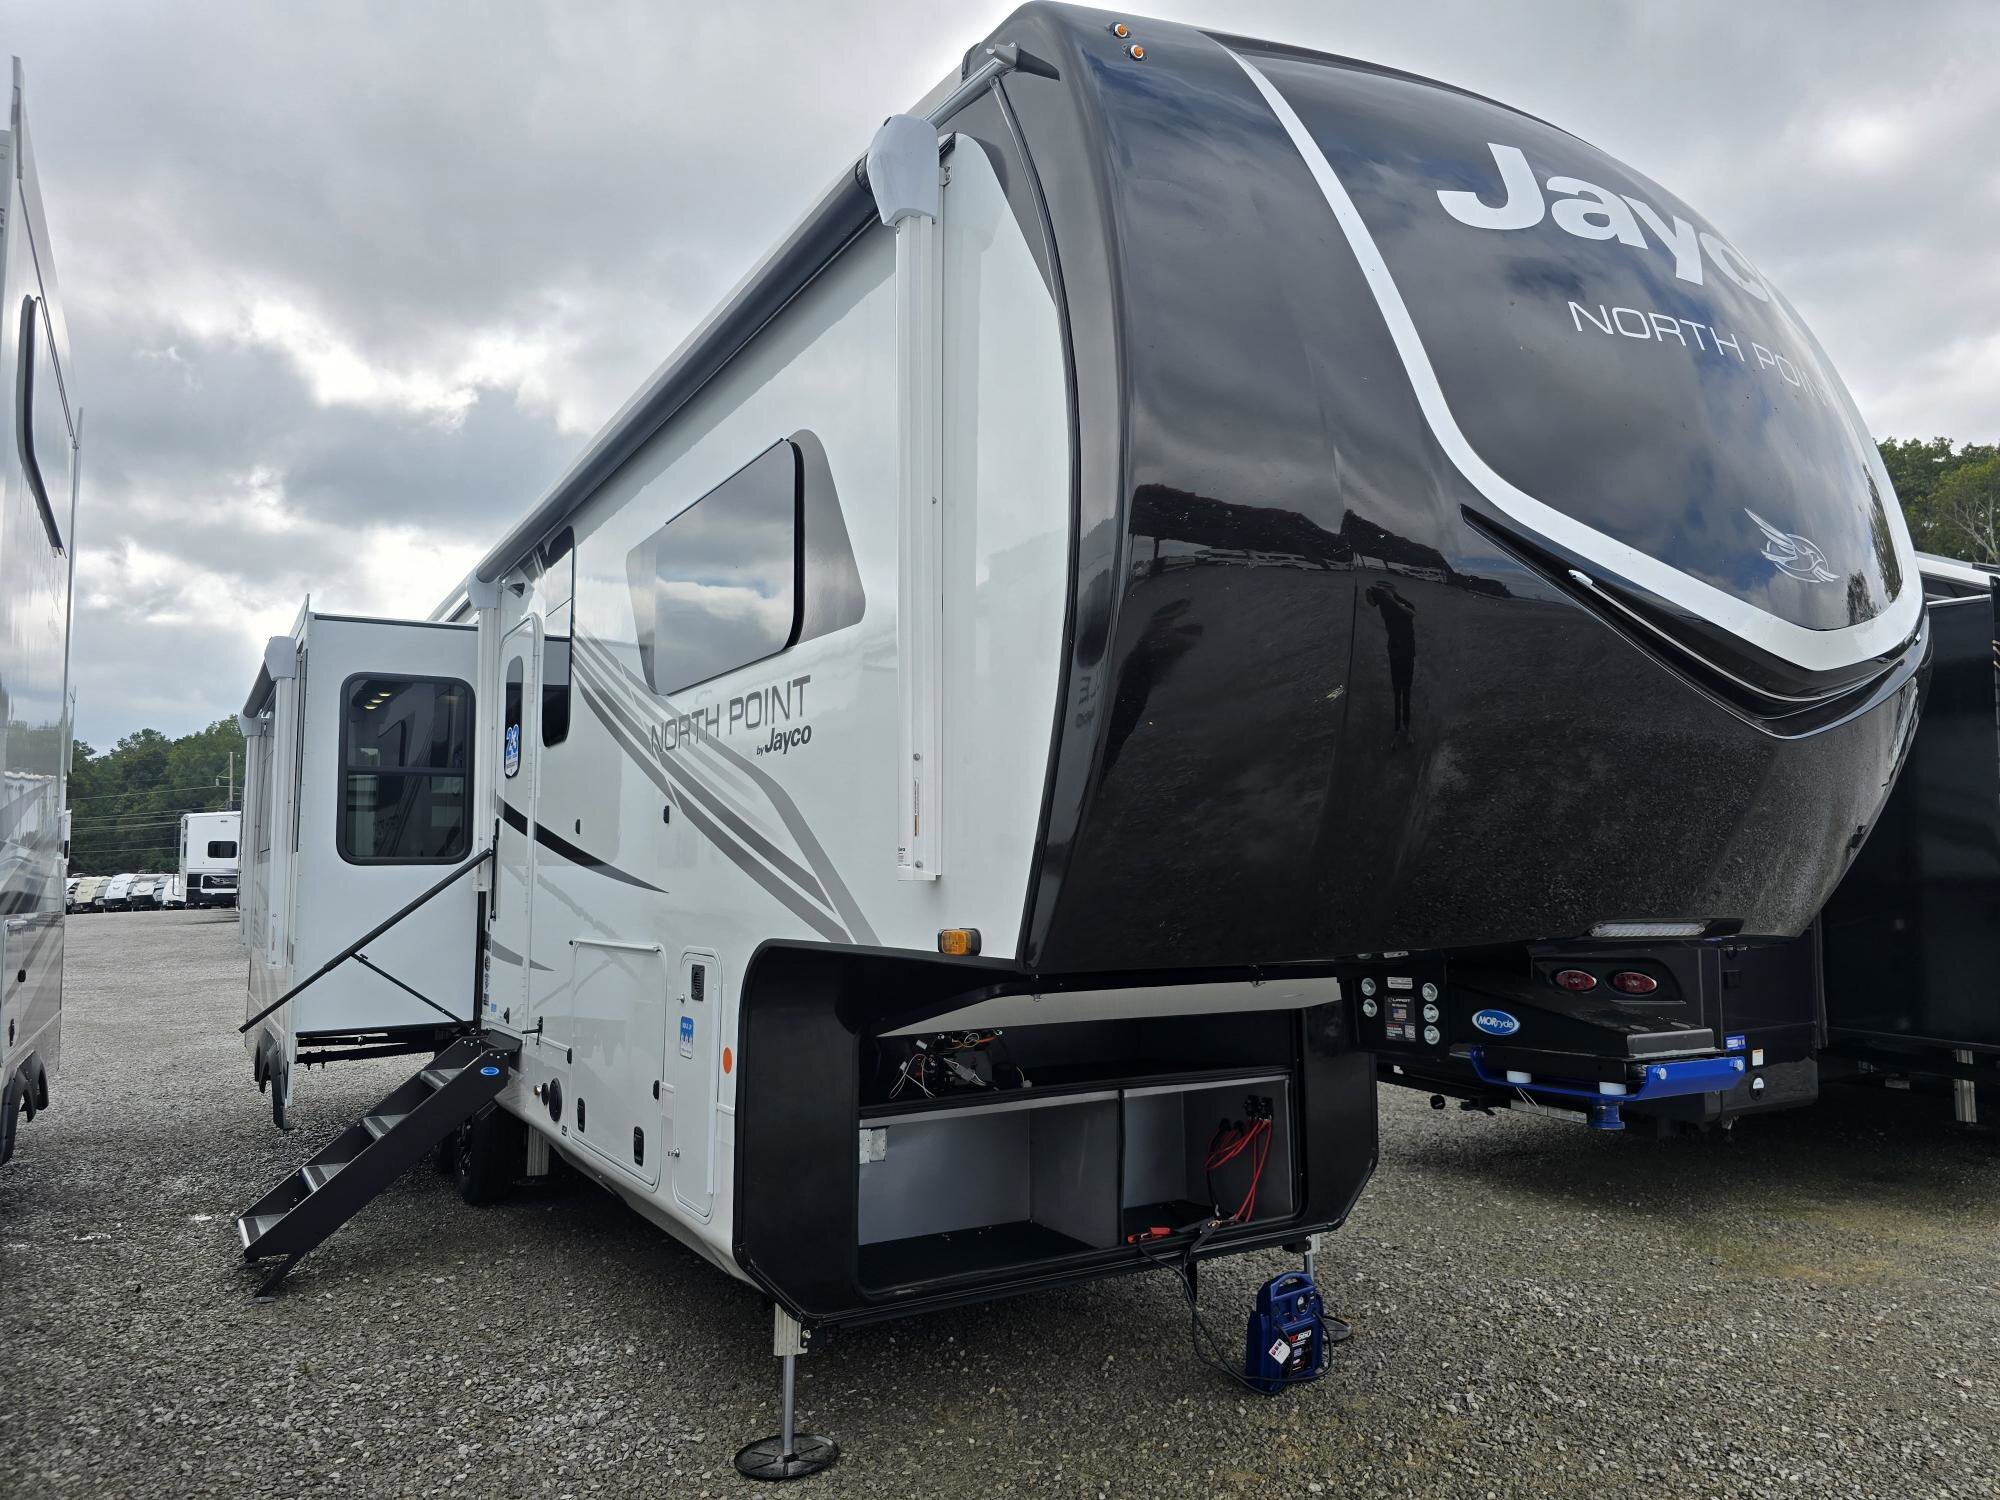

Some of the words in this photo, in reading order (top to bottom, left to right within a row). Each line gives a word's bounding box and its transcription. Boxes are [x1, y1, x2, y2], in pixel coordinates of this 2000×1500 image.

[1436, 142, 1769, 303] Jayc
[1567, 301, 1745, 362] NORTH
[1752, 342, 1832, 407] POIN
[651, 704, 720, 755] NORTH
[729, 674, 811, 735] POINT
[756, 745, 764, 757] by
[764, 725, 812, 754] Jayco
